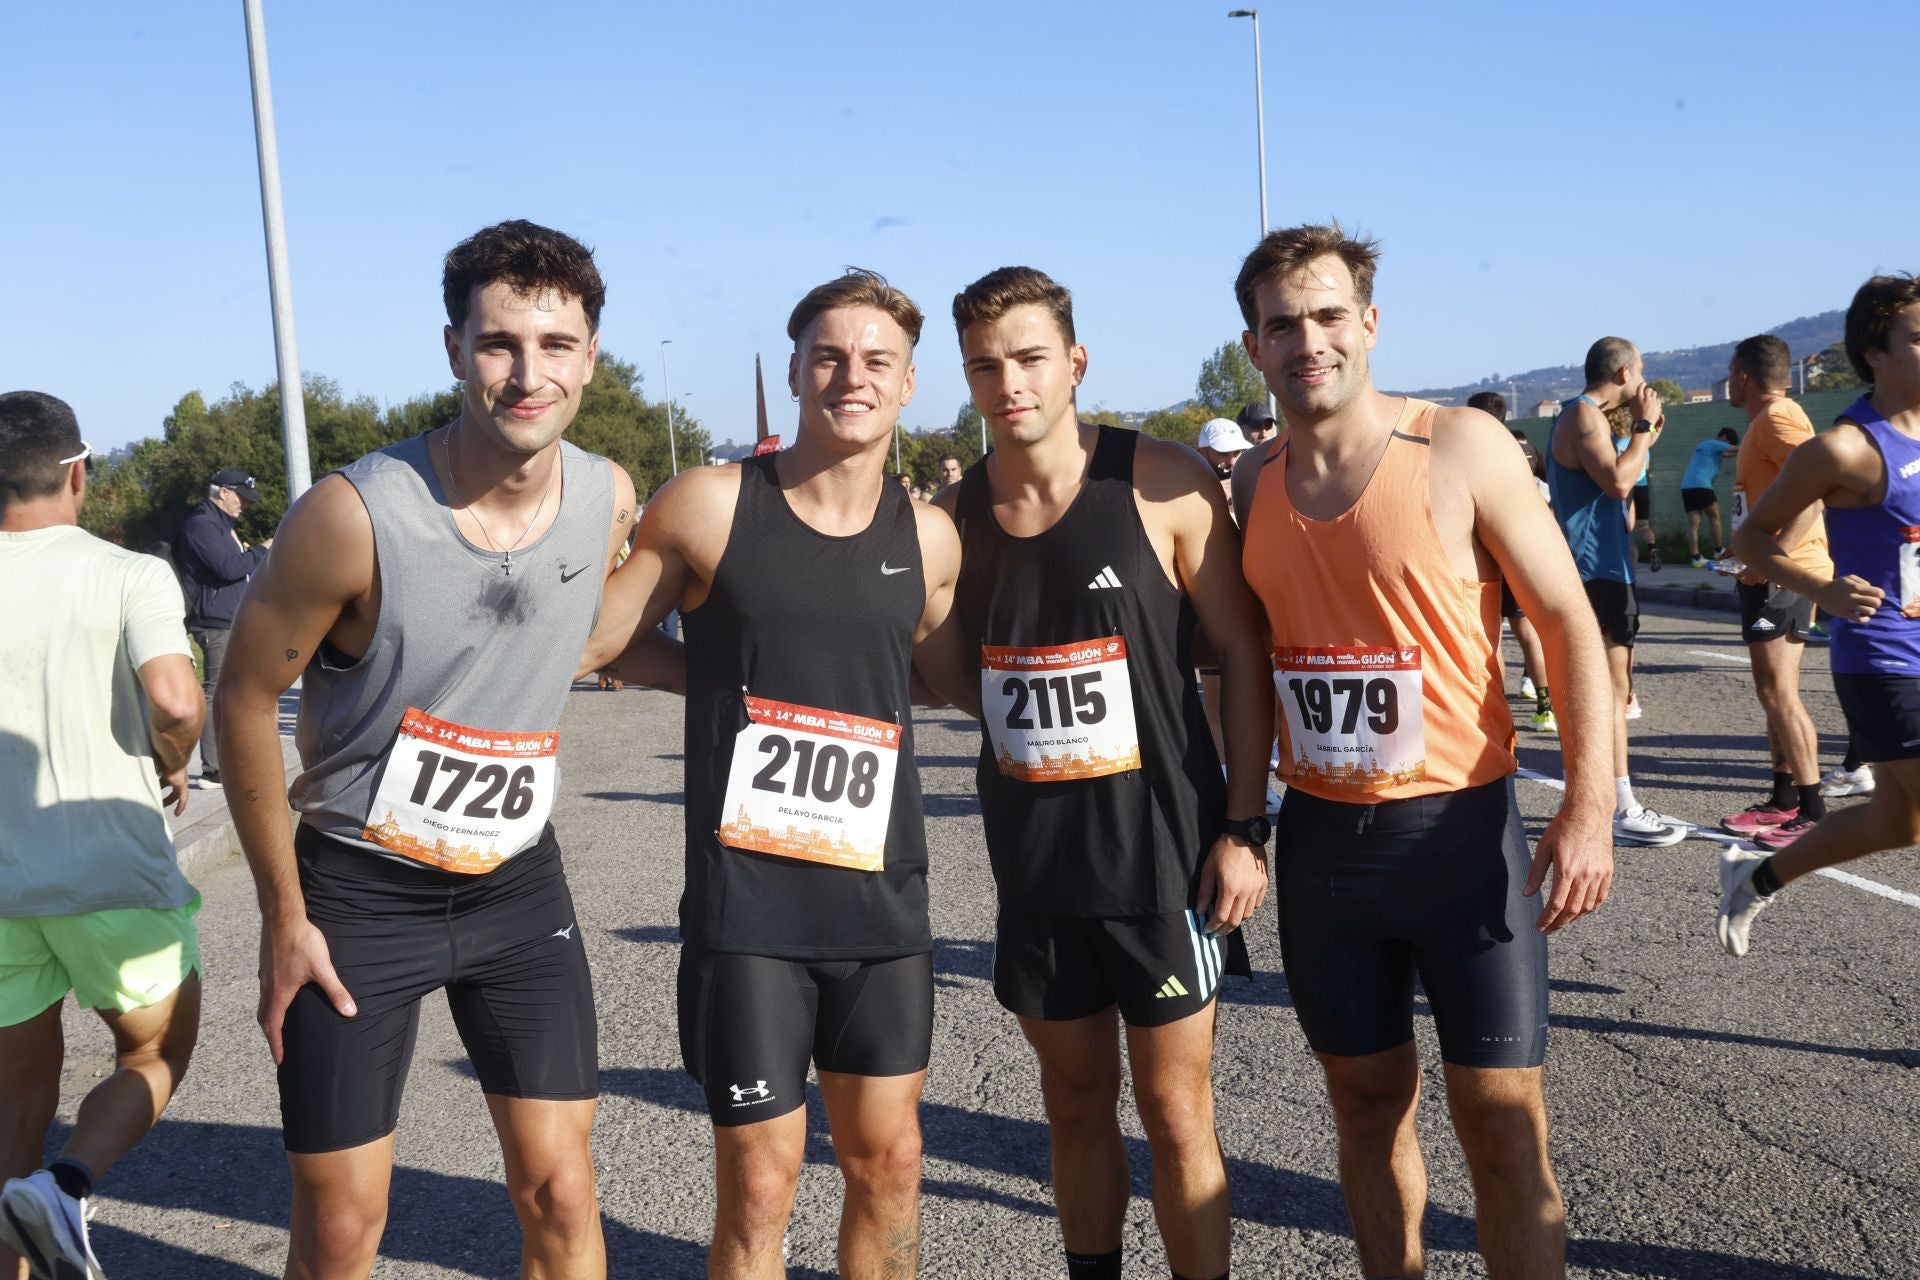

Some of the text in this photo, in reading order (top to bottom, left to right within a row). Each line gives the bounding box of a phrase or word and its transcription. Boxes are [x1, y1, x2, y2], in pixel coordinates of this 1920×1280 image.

[1017, 655, 1044, 665] MBA
[1069, 648, 1102, 662] GIJÓN
[1306, 655, 1335, 665] MBA
[1361, 652, 1395, 665] GIJÓN
[1003, 670, 1107, 730] 2115
[1289, 677, 1399, 735] 1979
[793, 713, 827, 729] MBA
[853, 724, 883, 740] GIJÓN
[457, 734, 491, 750] MBA
[515, 739, 542, 752] GIJÓN
[1027, 736, 1089, 748] MAURO BLANCO
[1343, 744, 1375, 753] GARCÍA
[751, 733, 880, 809] 2108
[409, 749, 536, 821] 1726
[778, 806, 810, 818] PELAYO
[422, 817, 501, 838] DIEGO FERNÁNDEZ
